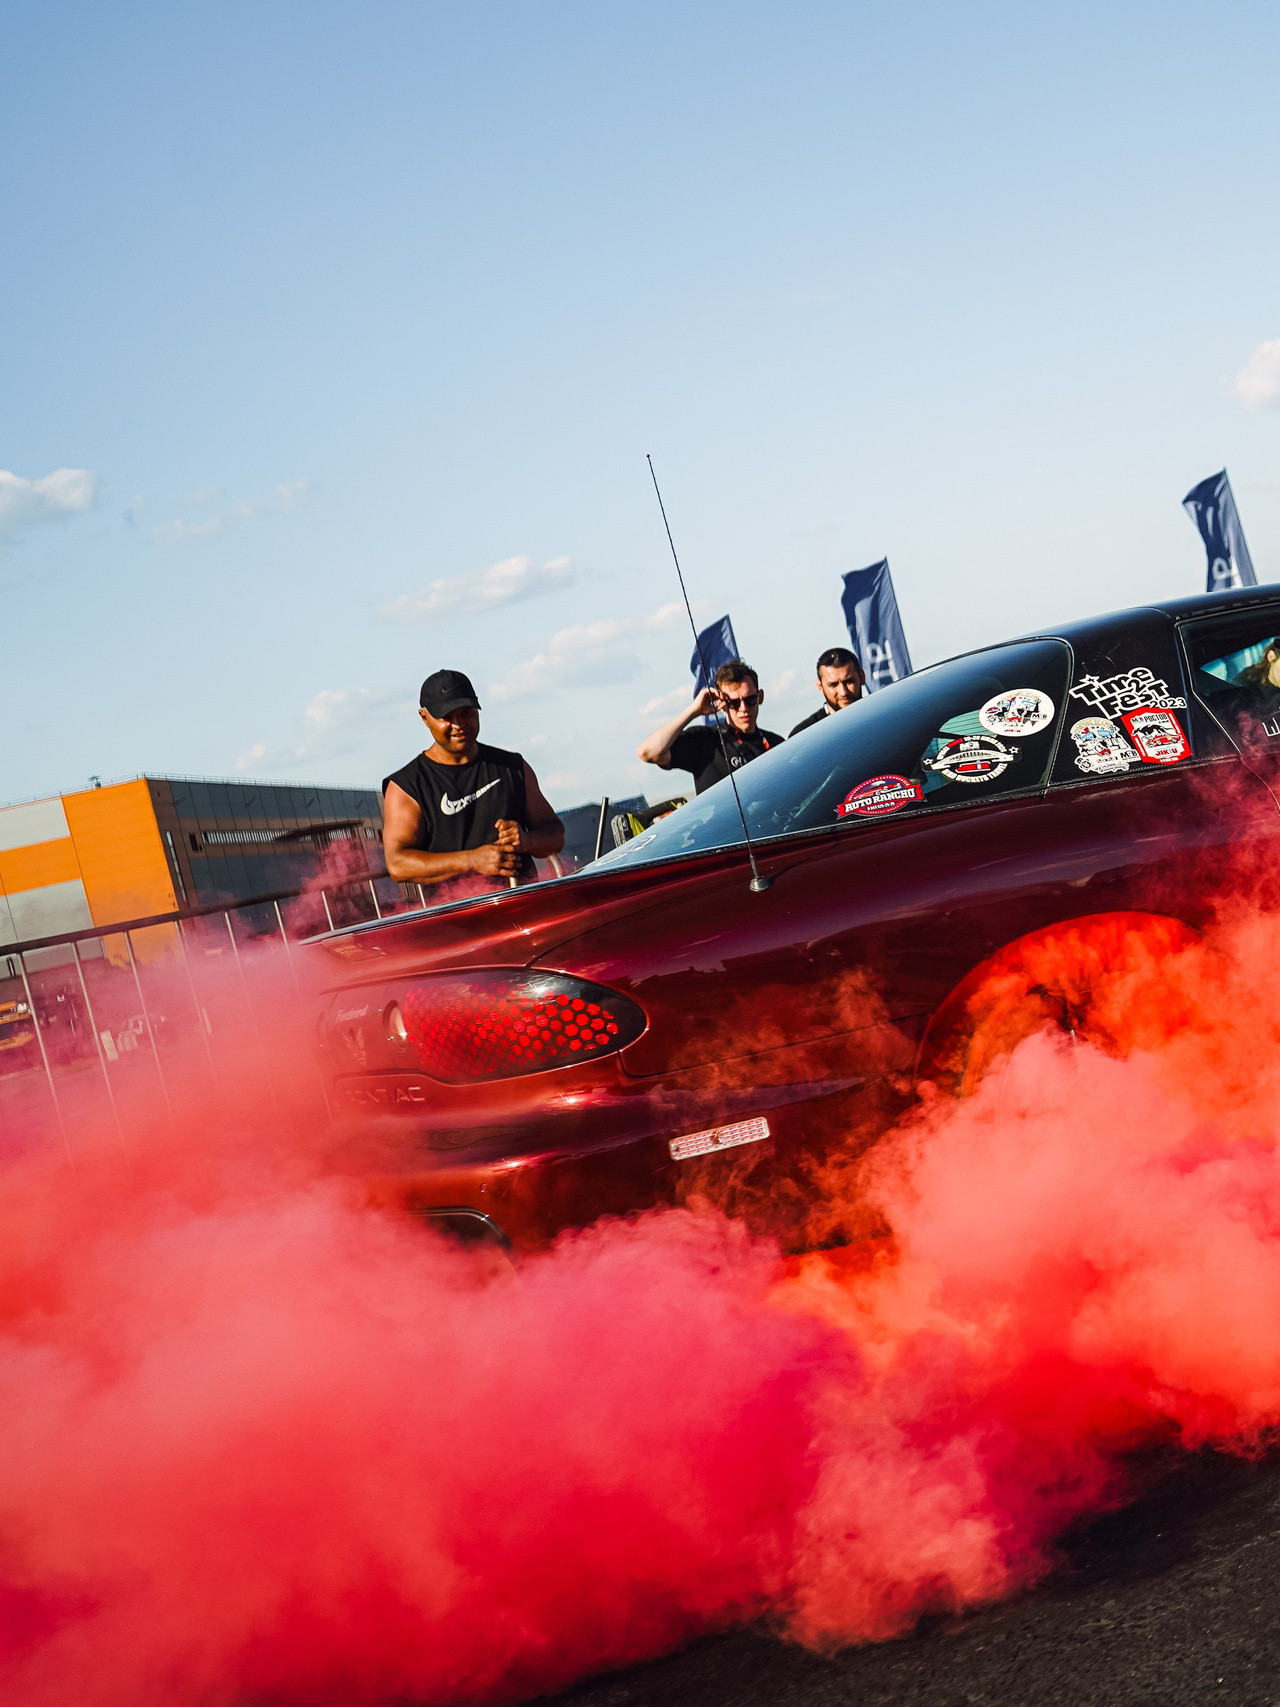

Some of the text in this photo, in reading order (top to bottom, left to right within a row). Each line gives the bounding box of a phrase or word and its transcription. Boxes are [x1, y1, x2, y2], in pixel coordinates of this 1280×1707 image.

[1149, 696, 1187, 709] 2023
[844, 797, 872, 812] AUTO
[872, 788, 916, 804] RANCHO
